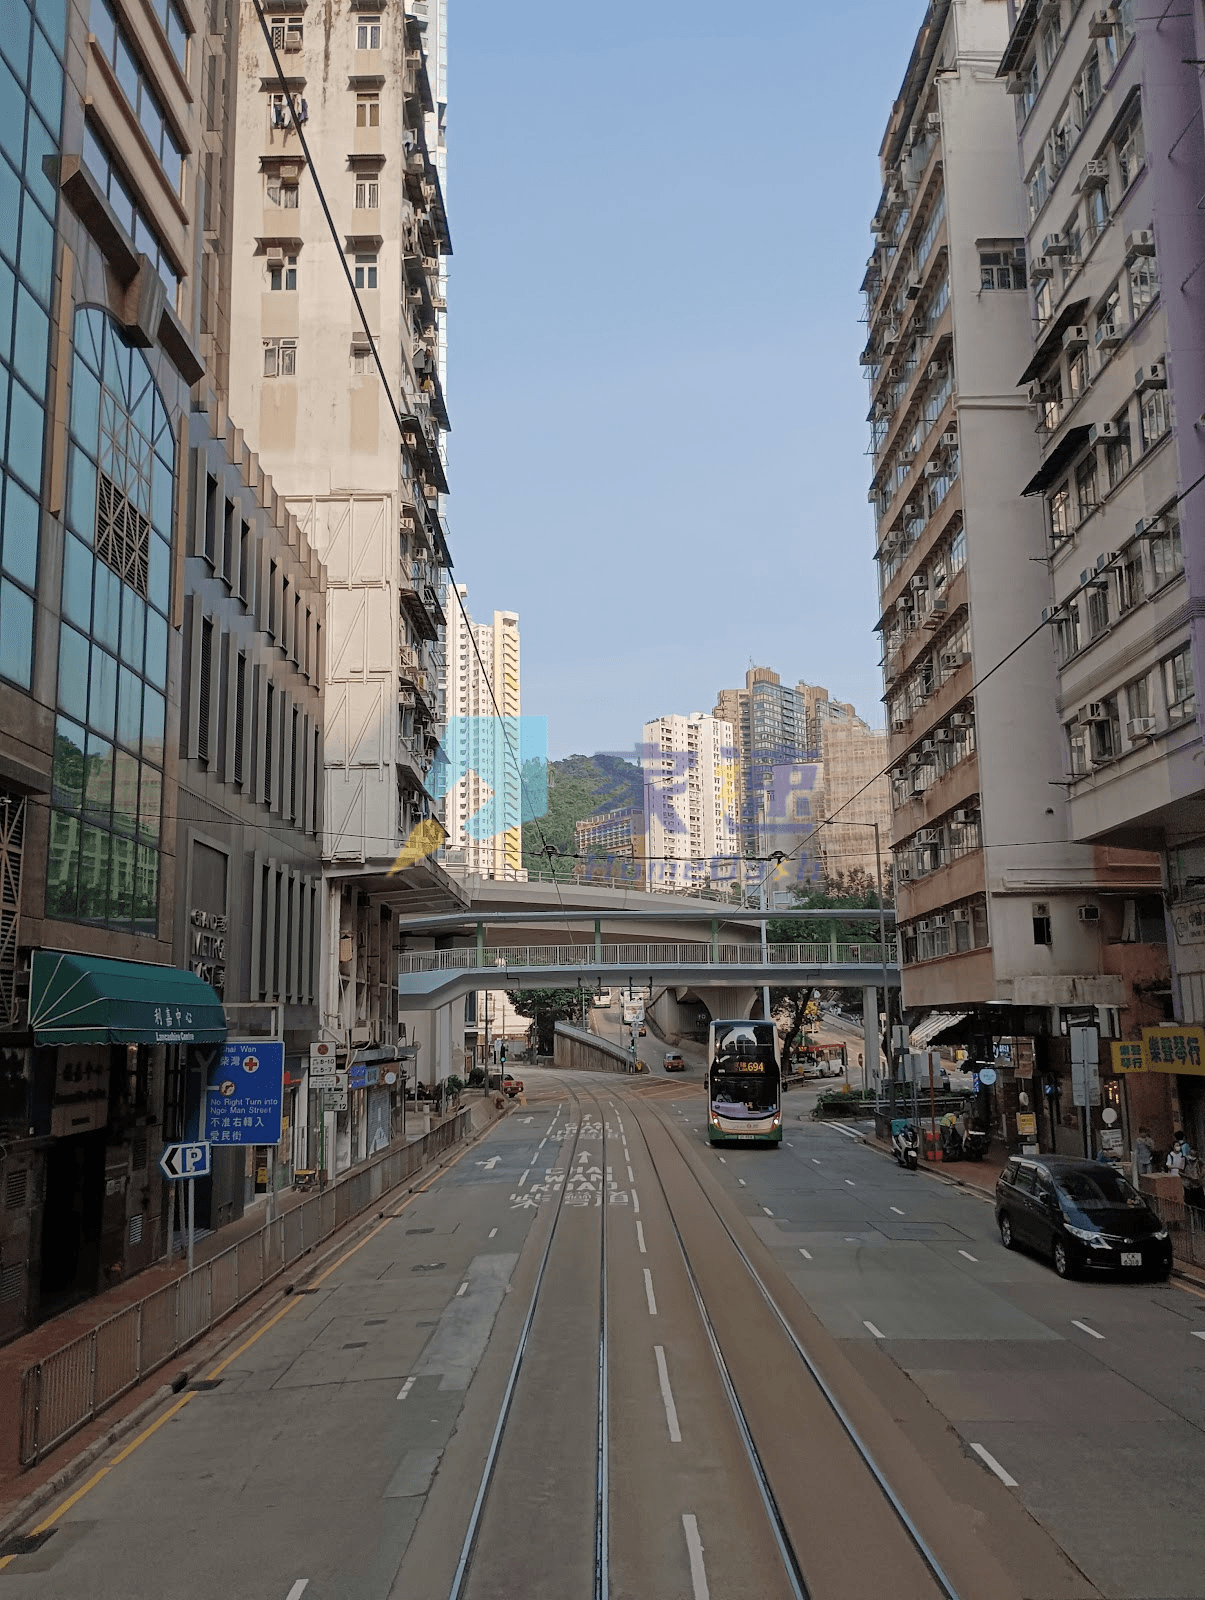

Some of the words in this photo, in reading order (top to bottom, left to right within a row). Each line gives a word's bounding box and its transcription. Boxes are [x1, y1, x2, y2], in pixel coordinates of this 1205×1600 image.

[190, 909, 217, 930] GRAND
[192, 931, 225, 959] METRO
[240, 1045, 257, 1053] Wan
[747, 1061, 764, 1072] 694
[224, 1098, 243, 1107] Right
[210, 1107, 228, 1115] Ngoi
[249, 1106, 272, 1114] Street
[185, 1148, 202, 1171] P
[545, 1166, 613, 1174] CHAI
[544, 1173, 613, 1183] WAN
[530, 1182, 618, 1192] ROAD
